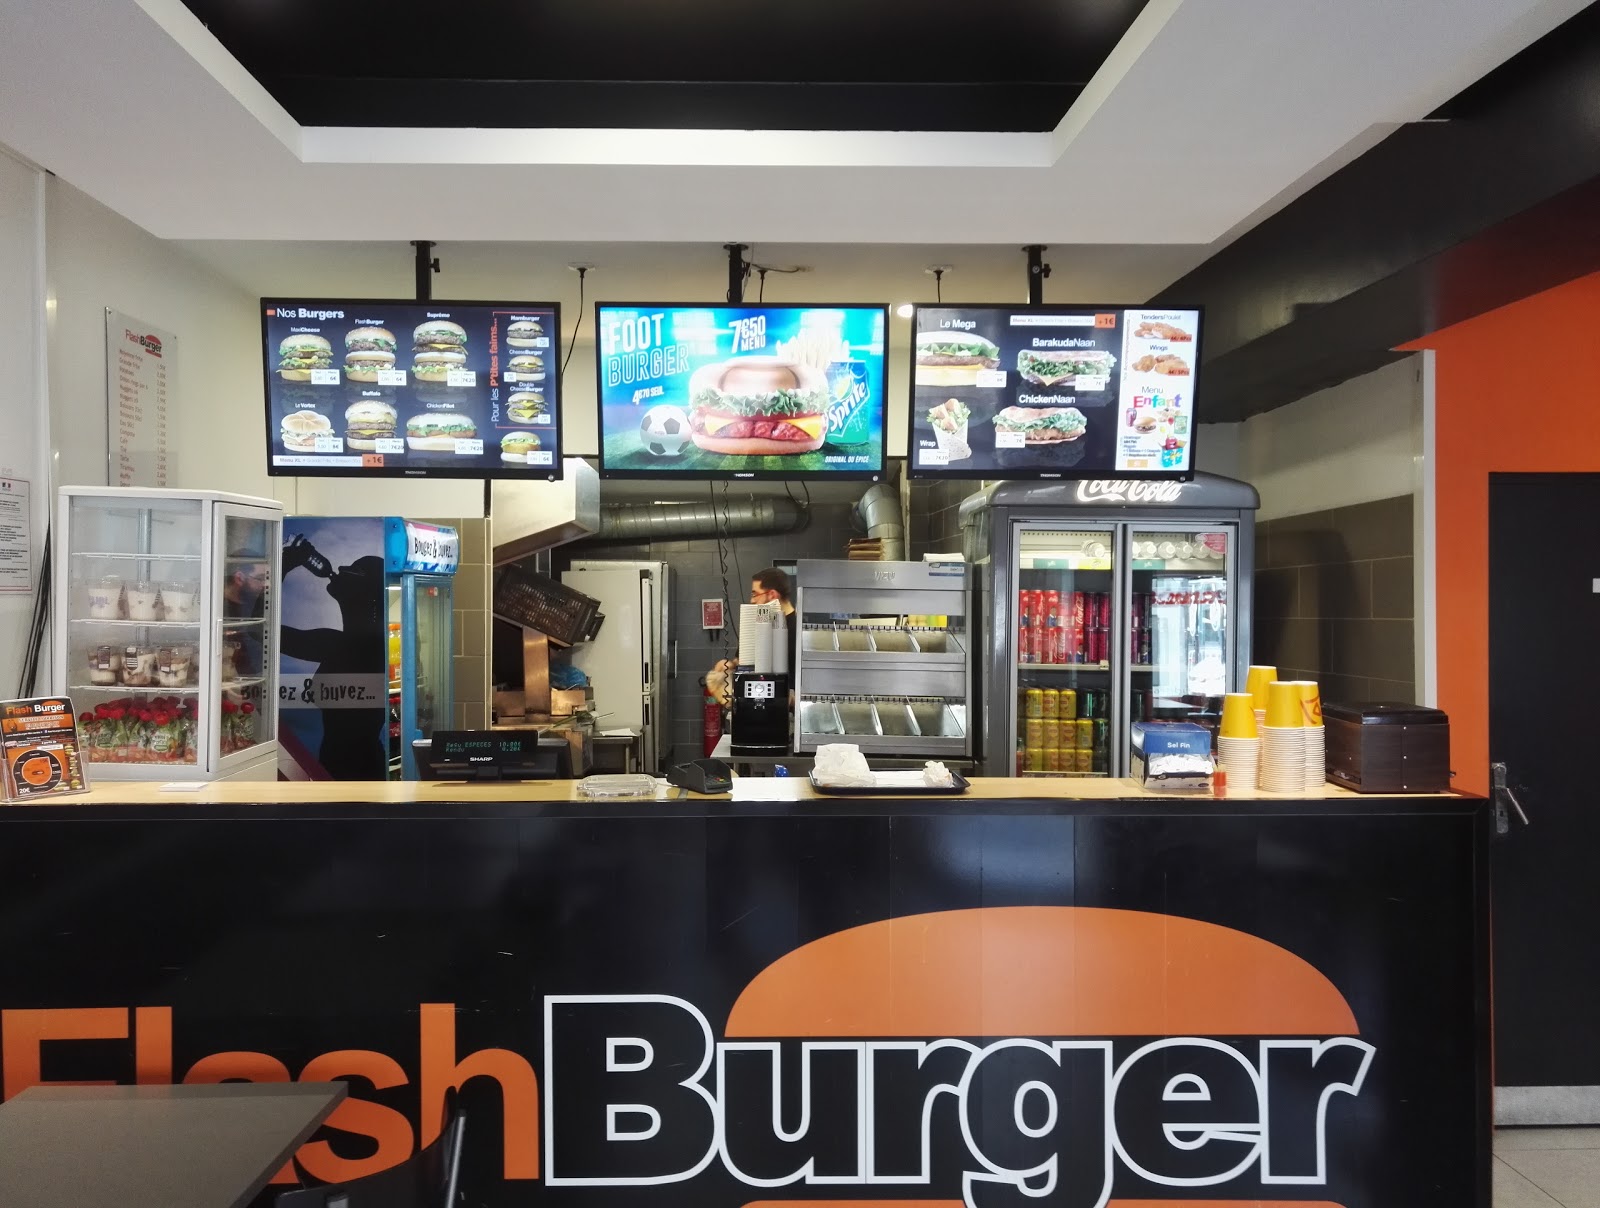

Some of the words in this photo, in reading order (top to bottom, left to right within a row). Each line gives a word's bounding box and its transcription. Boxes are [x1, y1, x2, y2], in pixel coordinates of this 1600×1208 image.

[277, 308, 296, 318] Nos
[298, 308, 344, 320] Burgers
[608, 313, 664, 355] FOOT
[728, 314, 766, 354] 7€50
[940, 319, 950, 328] Le
[952, 319, 976, 330] Mega
[126, 328, 162, 352] FlashBurger
[741, 335, 766, 351] MENU
[1032, 338, 1095, 347] BarakudaNaan
[490, 356, 498, 386] P'tites
[608, 343, 690, 387] BURGER
[650, 386, 664, 398] SEUL
[1019, 395, 1076, 403] ChickenNaan
[1133, 394, 1182, 408] Enfant
[491, 402, 499, 422] Pour
[828, 381, 866, 433] Sprite
[433, 539, 437, 558] &
[301, 678, 315, 704] &
[320, 683, 376, 702] buvez...
[6, 706, 32, 714] Flash
[34, 704, 65, 713] Burger
[2, 994, 1376, 1208] FshBurger
